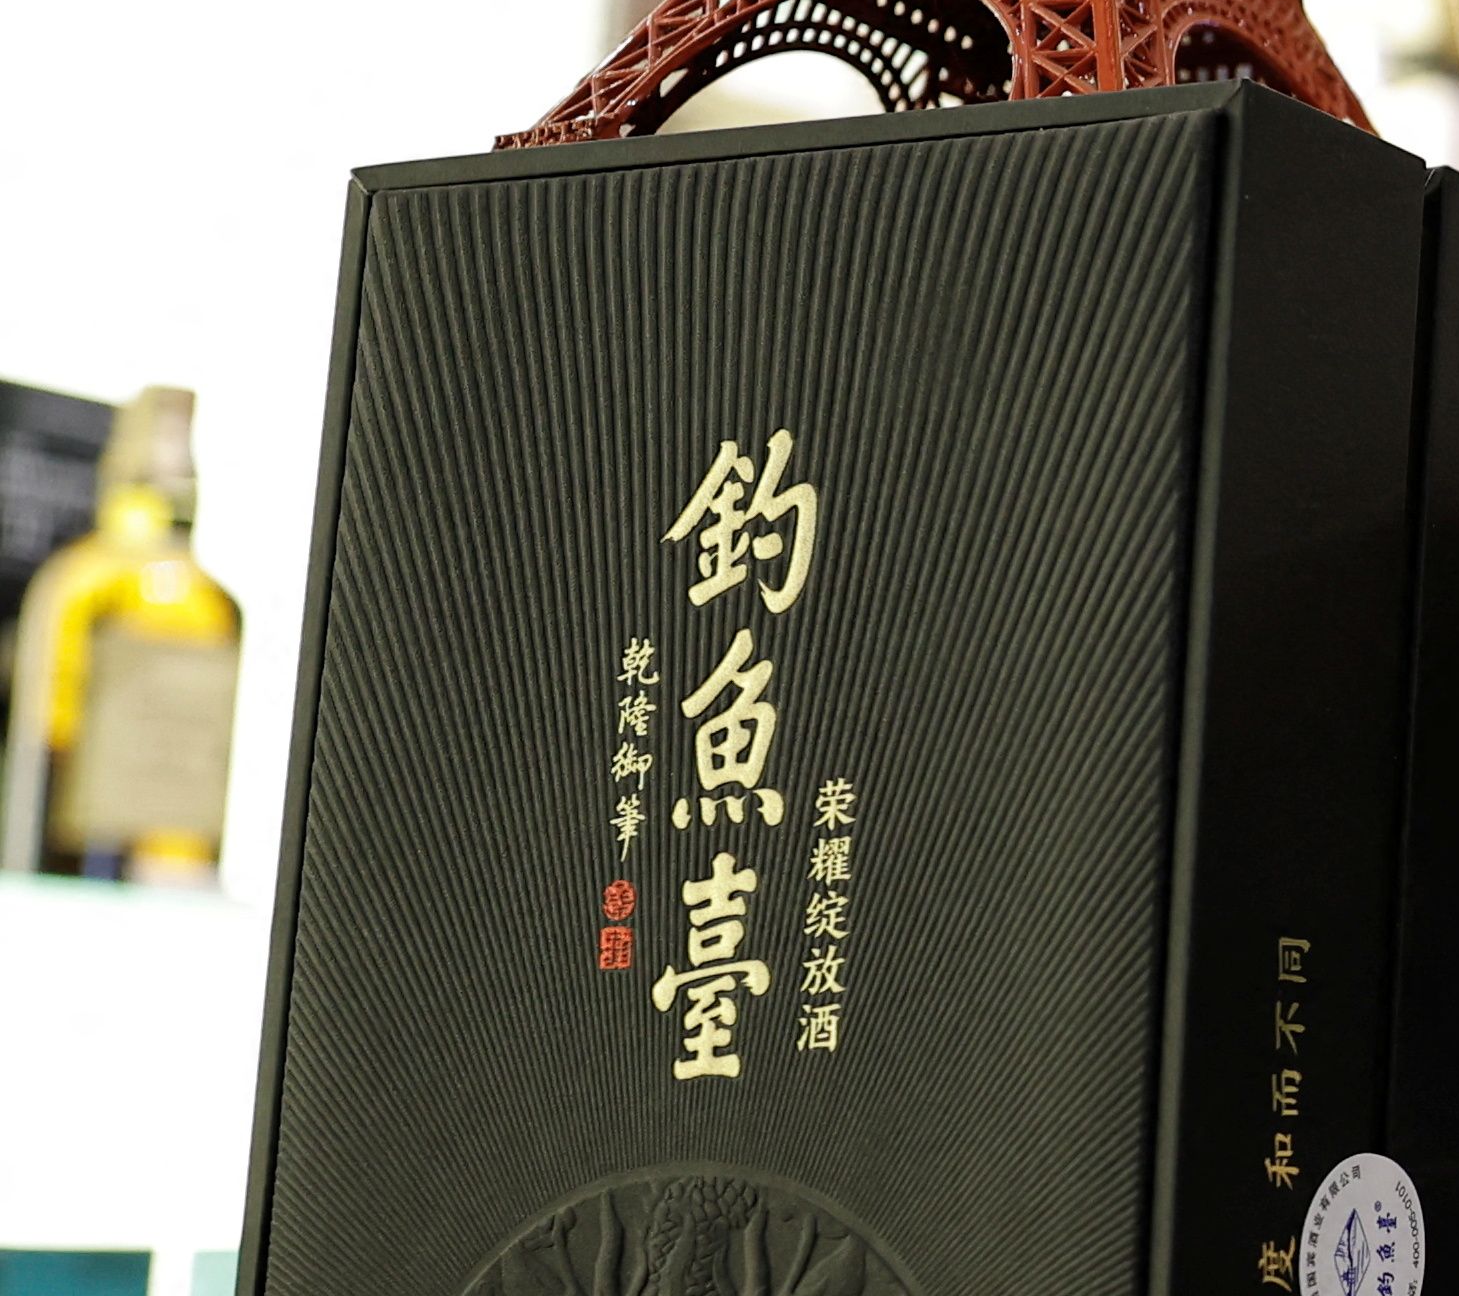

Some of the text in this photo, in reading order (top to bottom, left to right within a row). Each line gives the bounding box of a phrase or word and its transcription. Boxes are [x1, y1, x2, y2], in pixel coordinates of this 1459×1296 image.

[796, 776, 857, 1054] 荣耀绽放酒
[1265, 936, 1311, 1188] 和而不同
